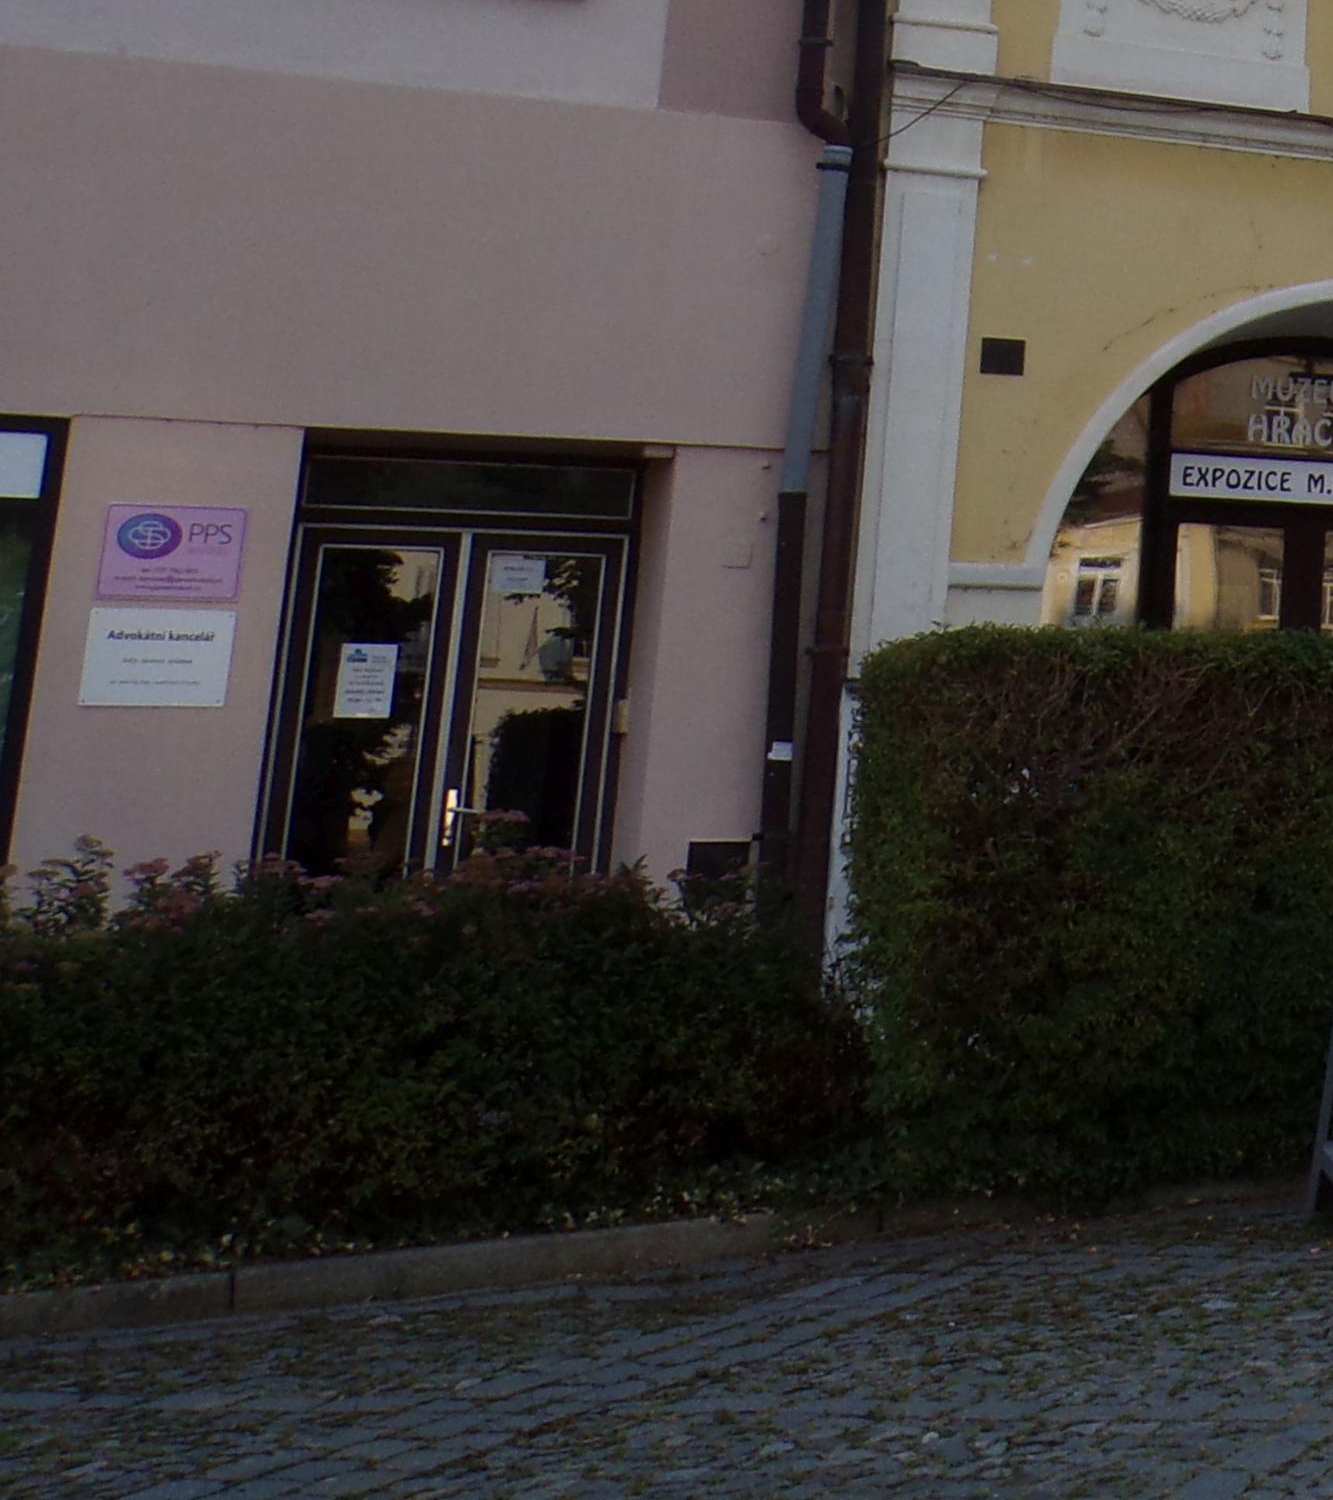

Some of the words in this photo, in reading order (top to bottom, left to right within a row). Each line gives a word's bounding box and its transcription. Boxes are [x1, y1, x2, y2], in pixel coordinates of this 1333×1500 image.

[1182, 466, 1292, 492] EXPOZICE
[189, 522, 232, 545] PPS
[106, 629, 166, 641] Advokátní
[168, 630, 216, 642] kancelář
